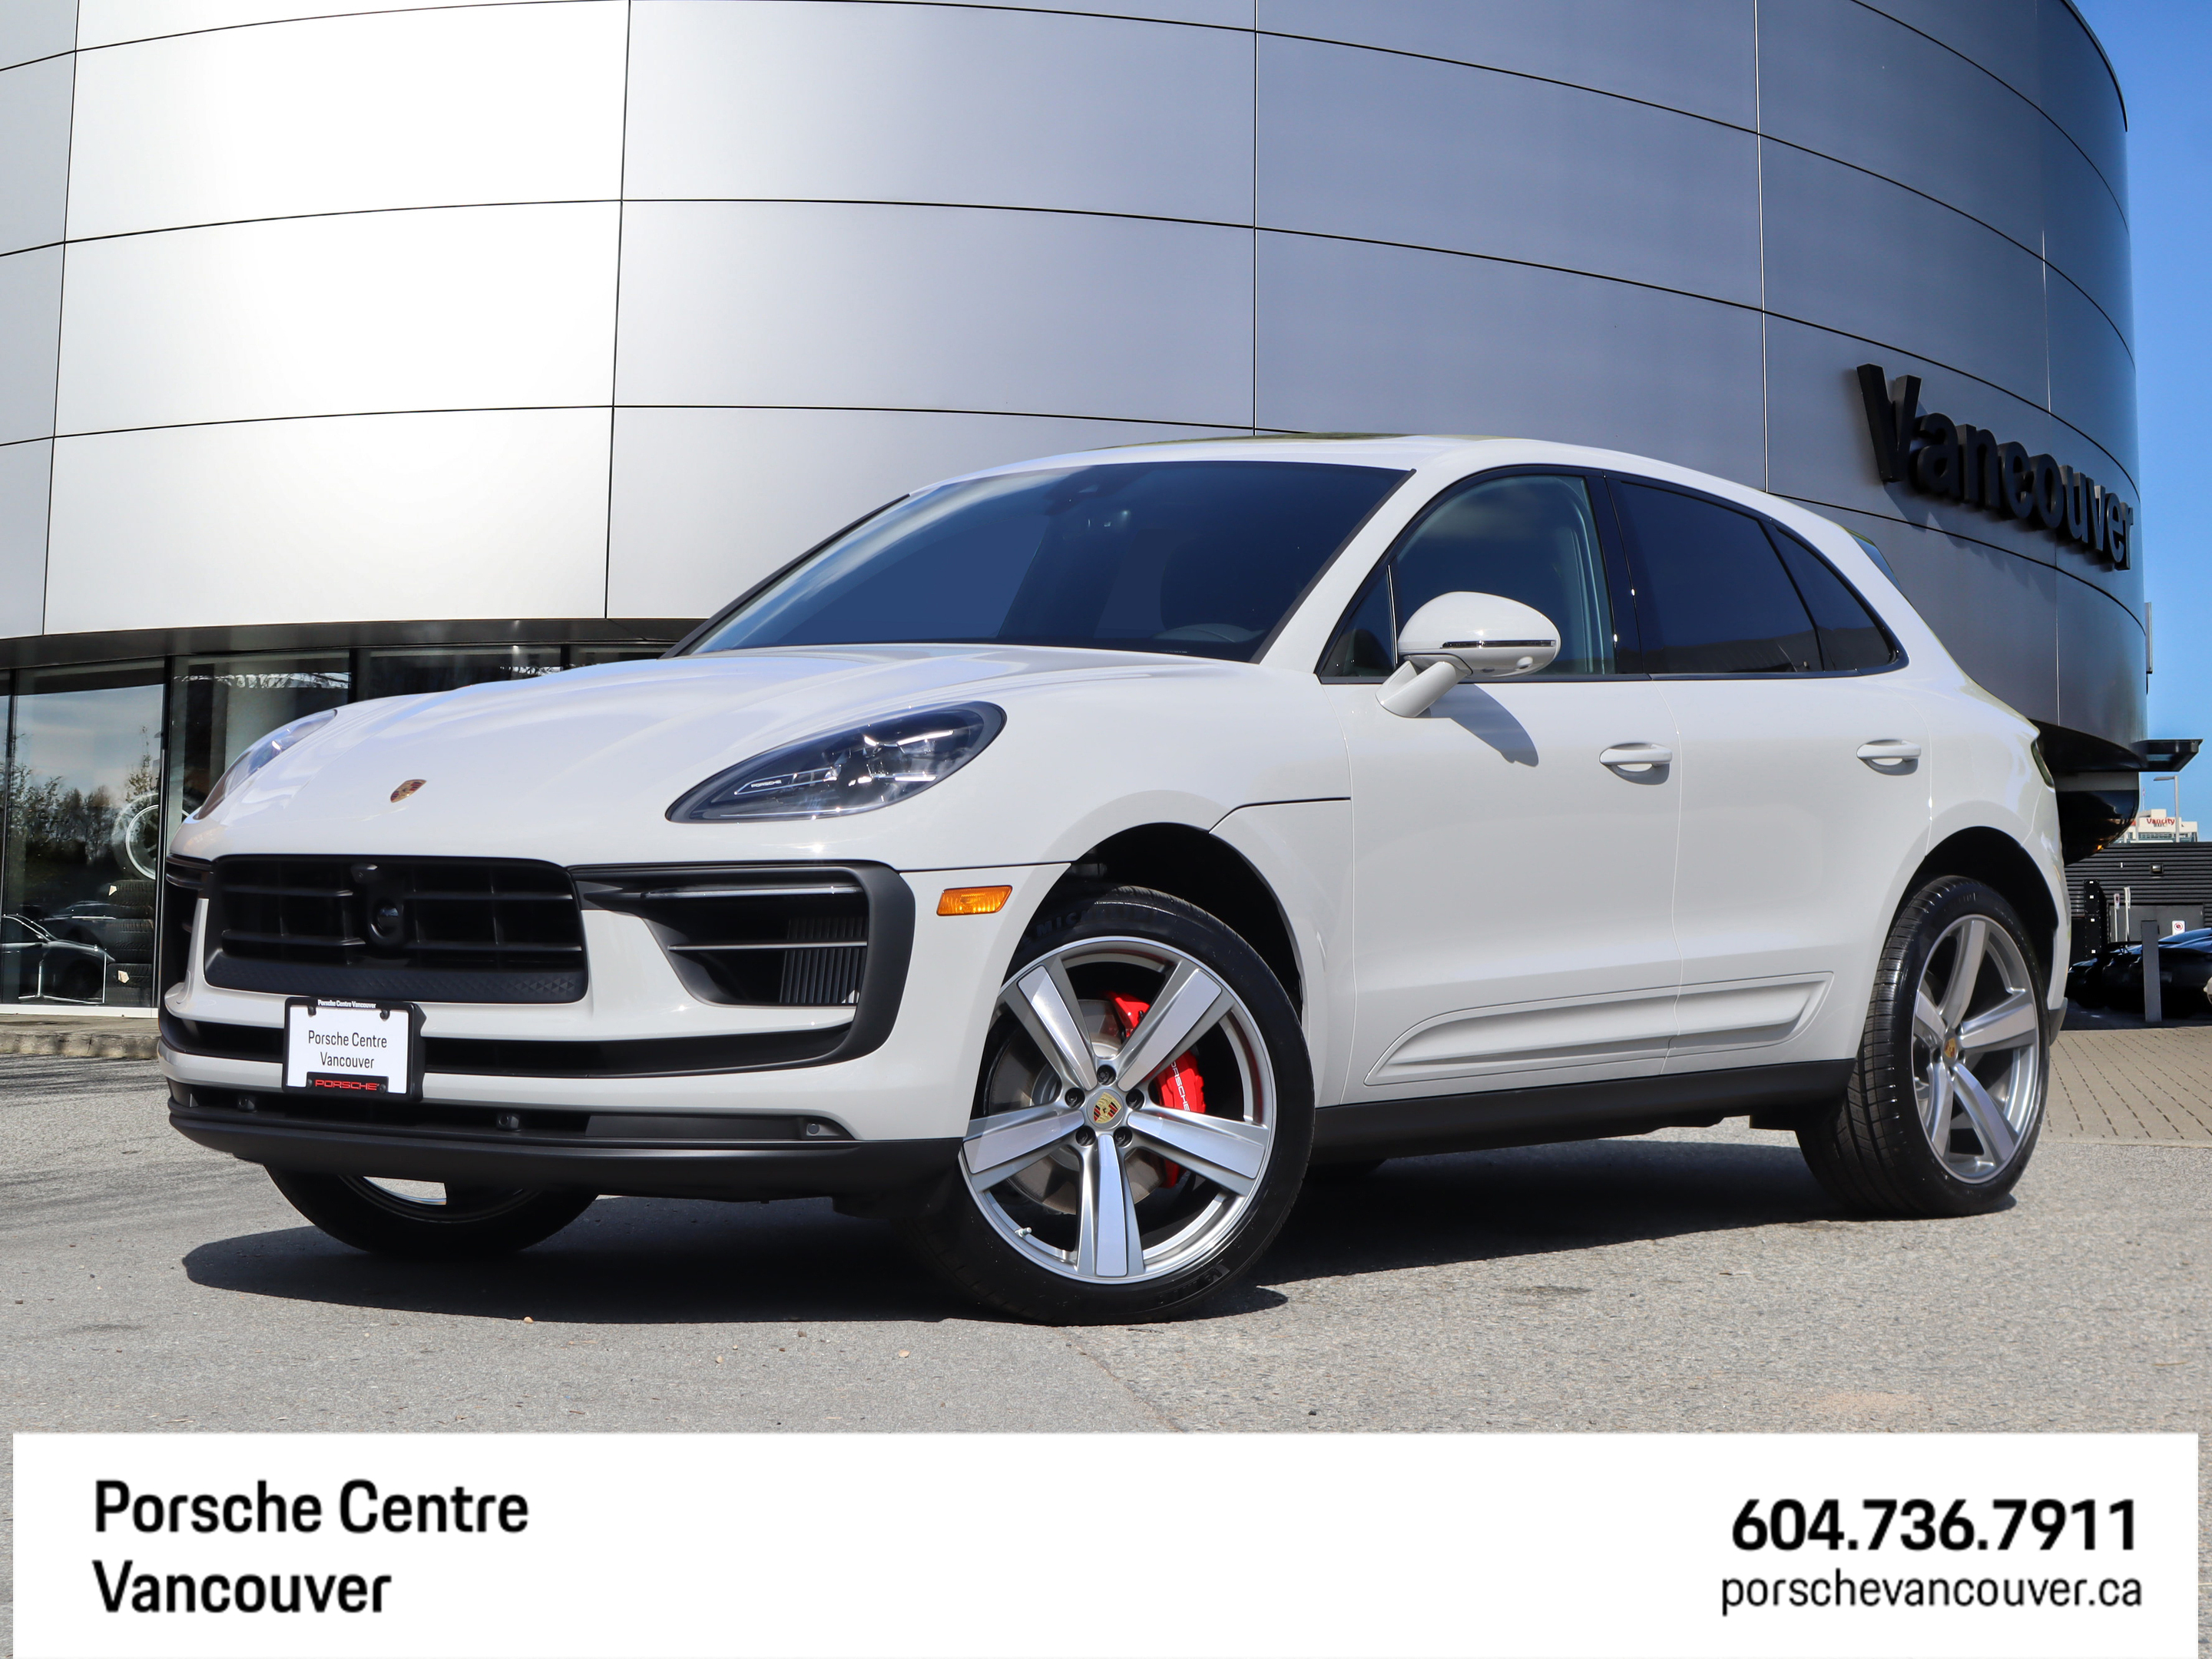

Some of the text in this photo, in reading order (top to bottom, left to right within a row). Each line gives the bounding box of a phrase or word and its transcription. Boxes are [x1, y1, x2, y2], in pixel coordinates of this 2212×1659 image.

[1856, 363, 2134, 571] Vancouver
[308, 1030, 387, 1048] Porsche Centre
[320, 1051, 375, 1068] Vancouver
[315, 1079, 379, 1091] PORSCHE
